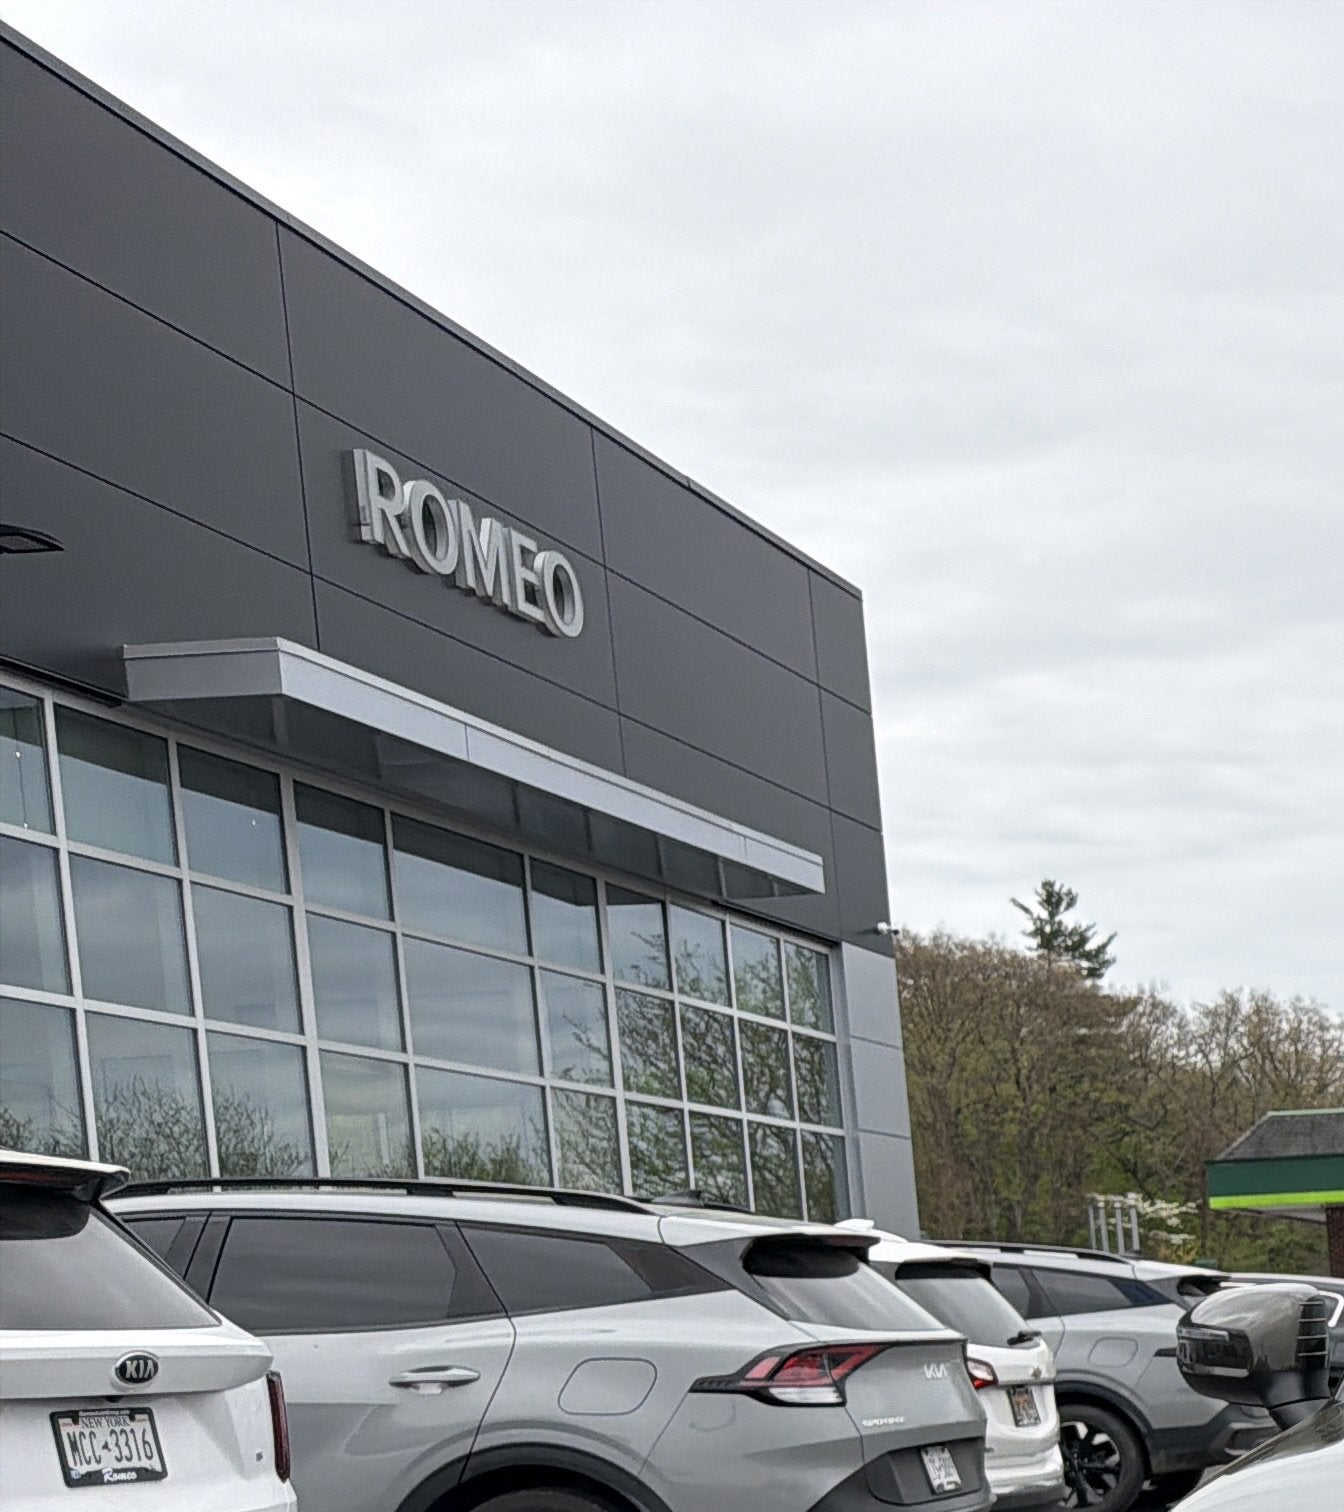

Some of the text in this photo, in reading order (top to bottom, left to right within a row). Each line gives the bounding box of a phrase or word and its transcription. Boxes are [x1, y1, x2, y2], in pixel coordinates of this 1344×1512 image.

[353, 449, 584, 637] ROMEO
[125, 1360, 155, 1379] KIA
[81, 1414, 130, 1429] NEW YORK
